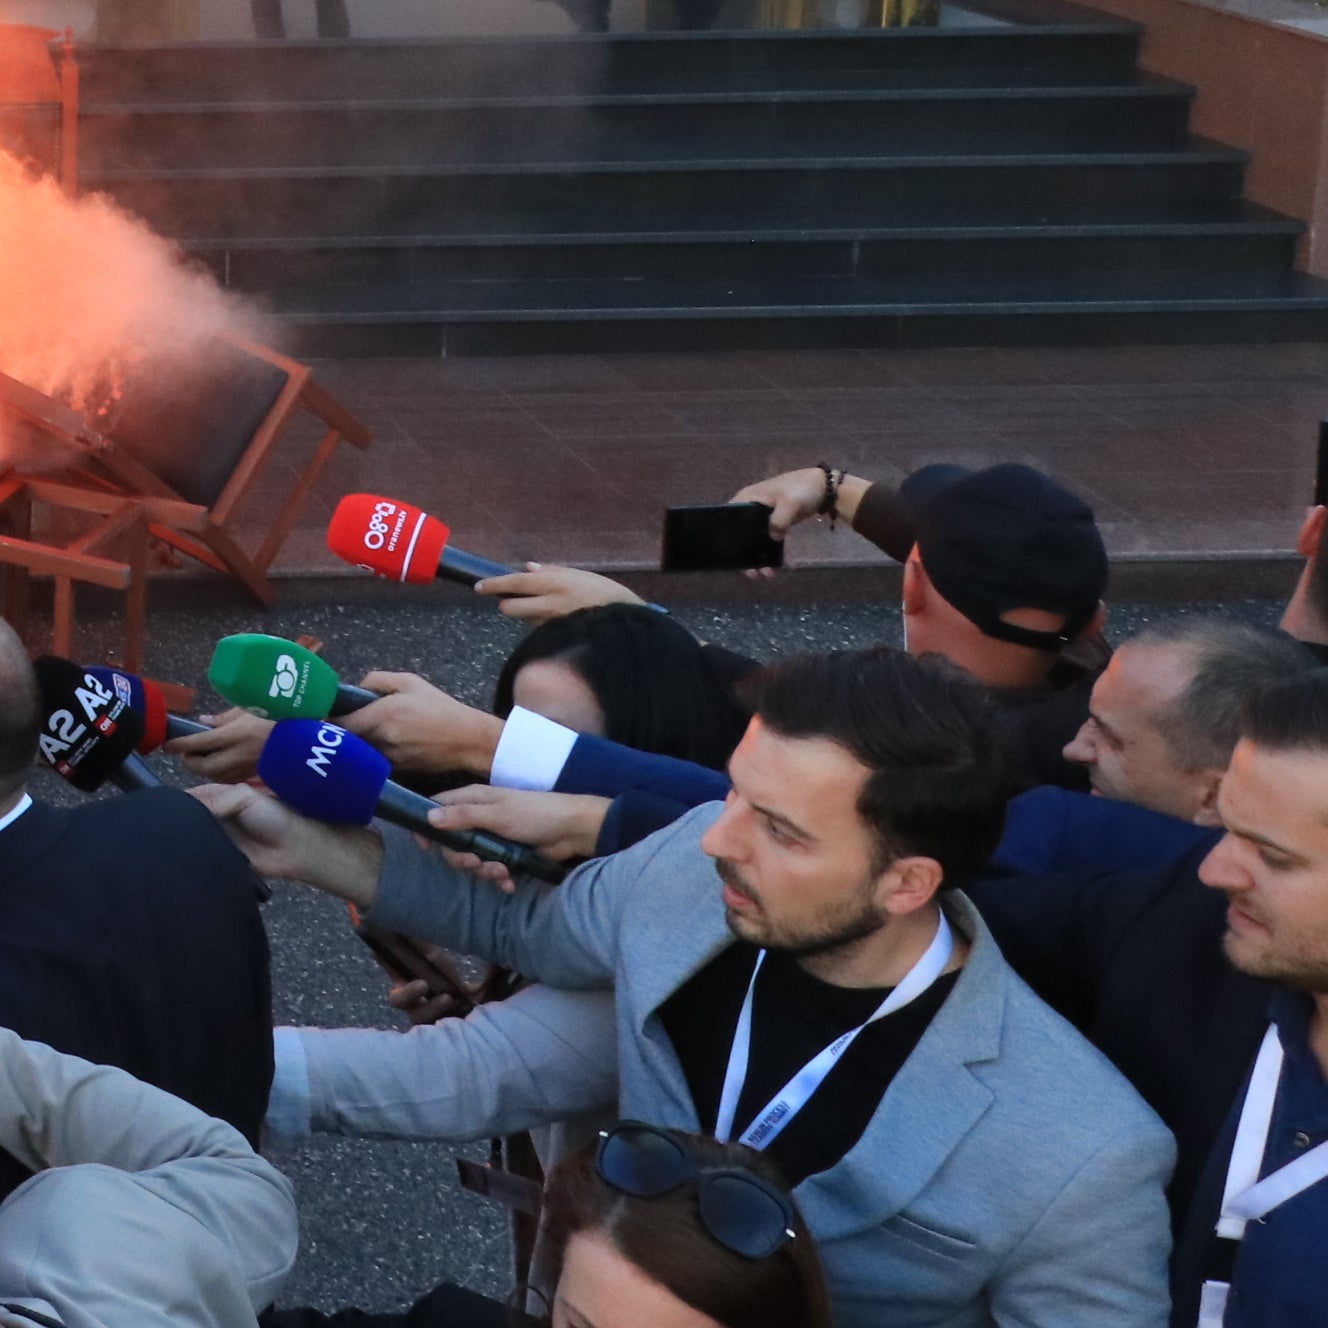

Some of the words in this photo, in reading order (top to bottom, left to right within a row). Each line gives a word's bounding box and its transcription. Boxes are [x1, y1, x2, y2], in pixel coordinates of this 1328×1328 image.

[387, 511, 407, 552] oranews.tv
[74, 673, 113, 722] A2
[296, 660, 311, 693] CHANNEL
[39, 709, 87, 764] A2
